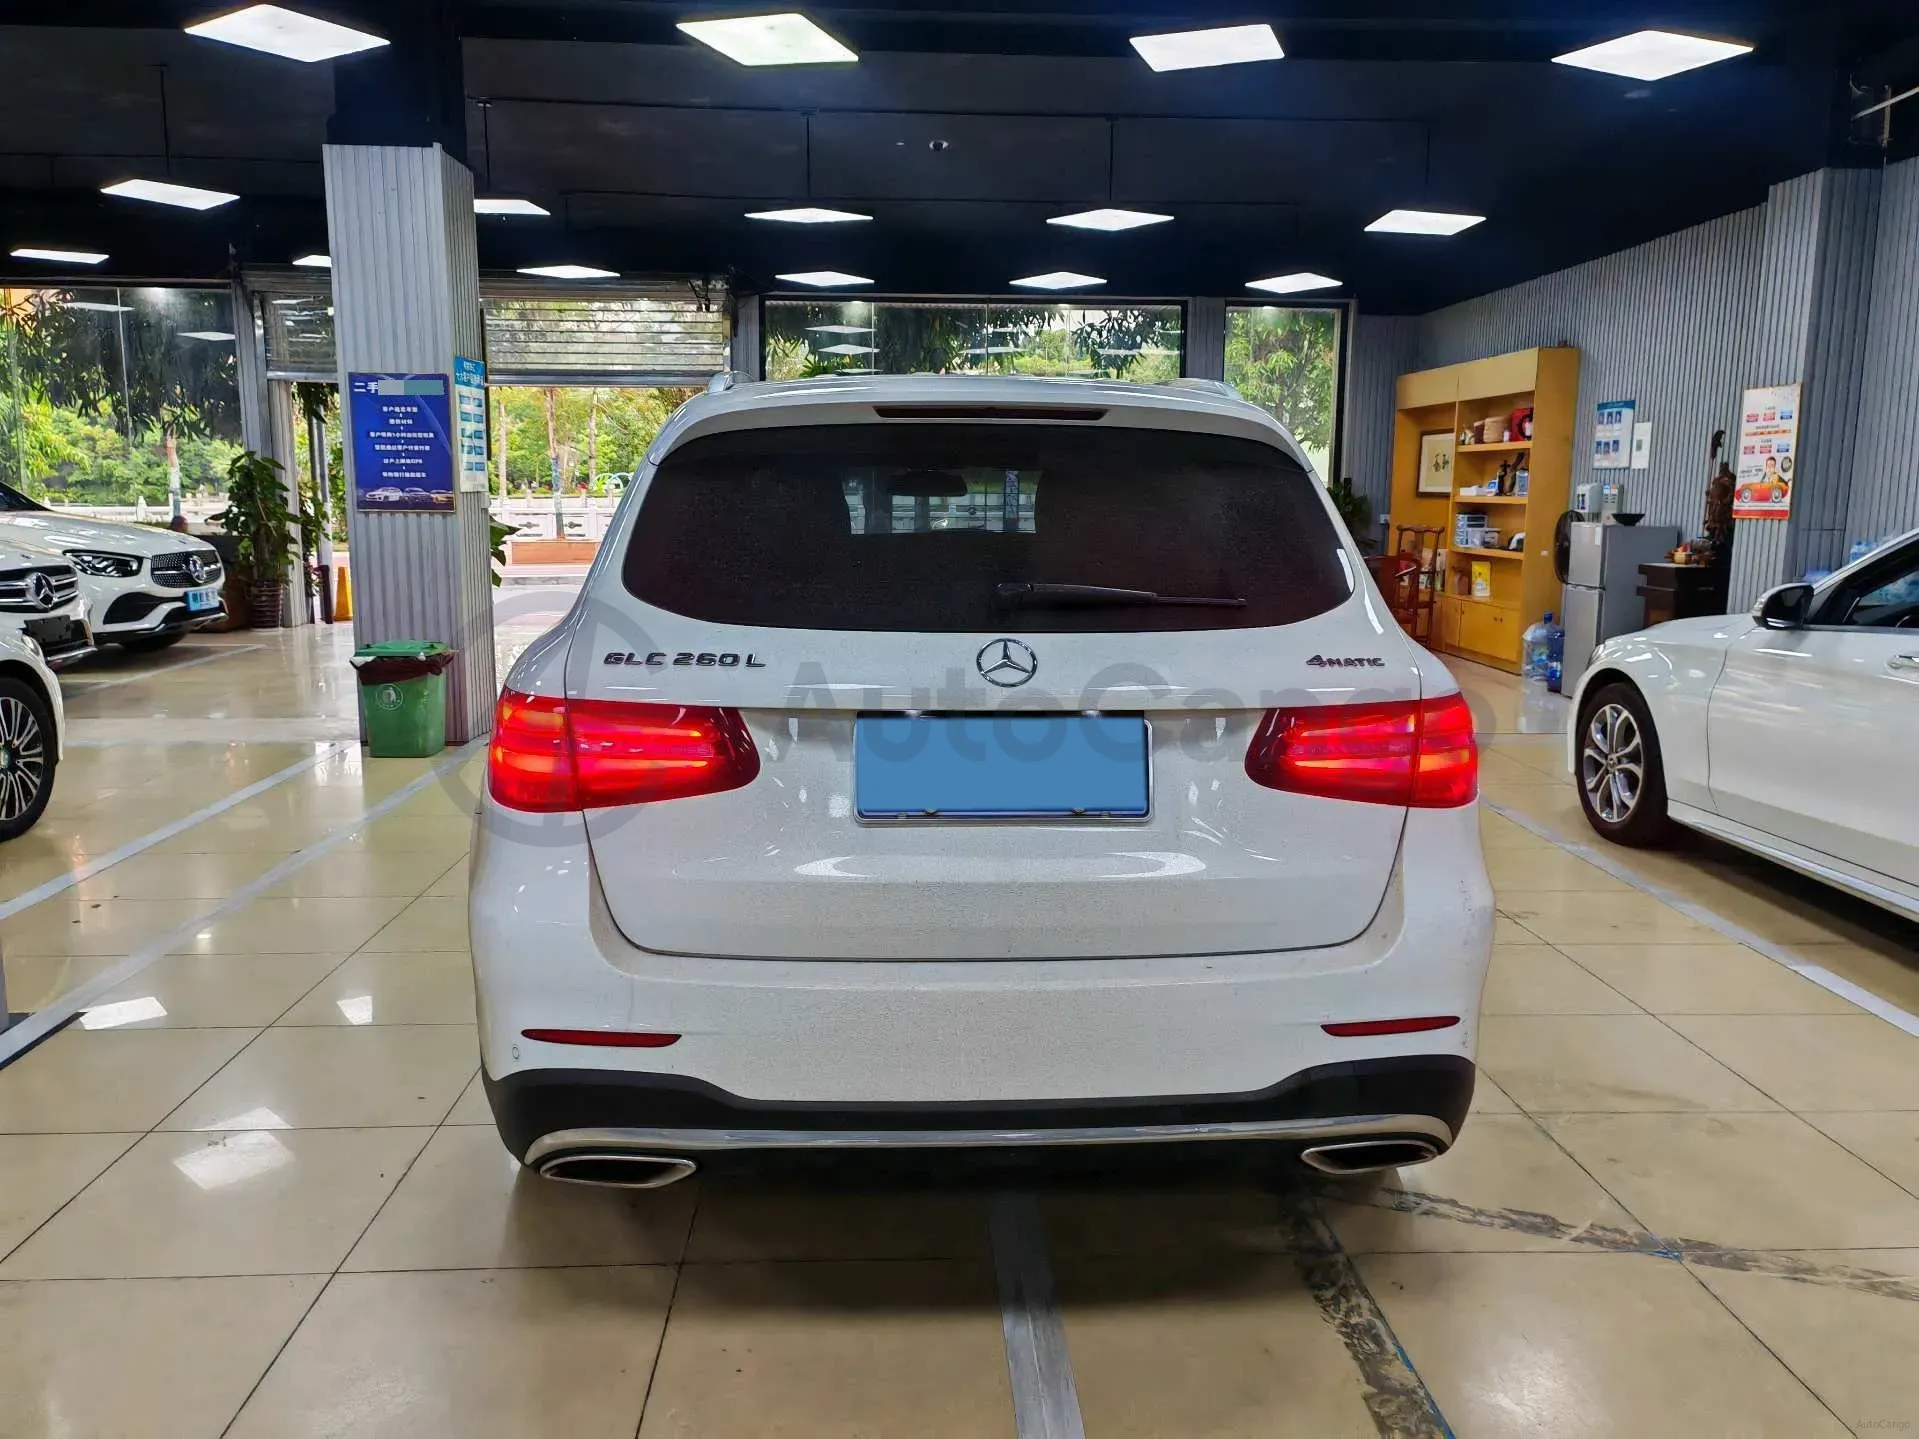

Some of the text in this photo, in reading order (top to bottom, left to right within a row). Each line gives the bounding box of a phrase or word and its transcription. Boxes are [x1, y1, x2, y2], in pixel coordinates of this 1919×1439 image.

[603, 652, 767, 668] GLC 260 L
[1305, 654, 1386, 668] 4MATIC
